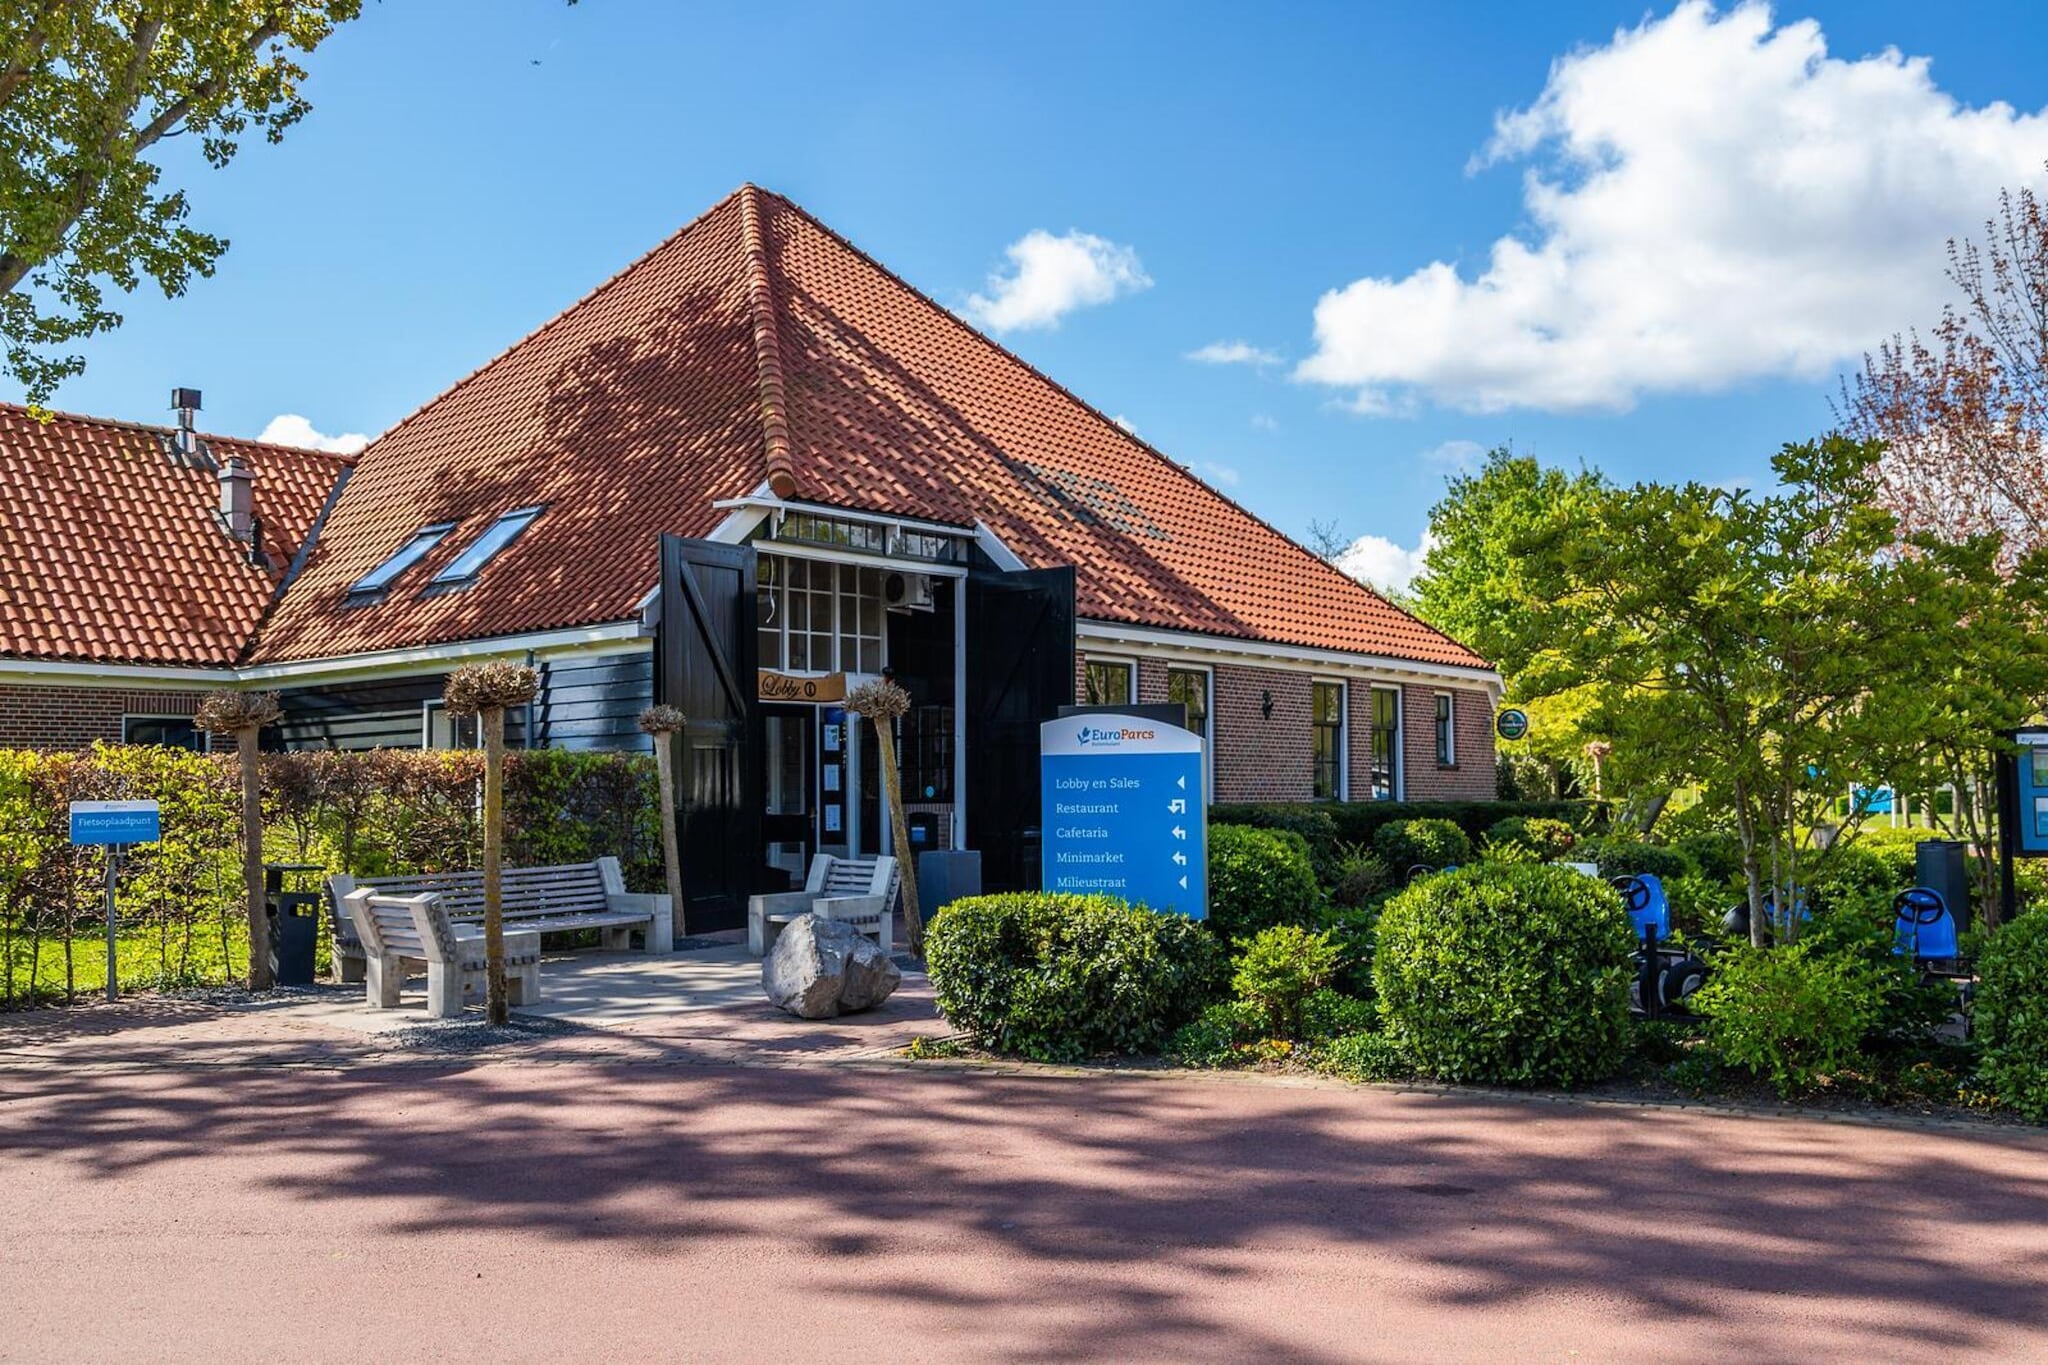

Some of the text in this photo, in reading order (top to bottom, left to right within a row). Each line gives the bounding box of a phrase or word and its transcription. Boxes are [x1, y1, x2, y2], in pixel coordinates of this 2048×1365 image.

[761, 675, 801, 699] Lobby
[1092, 728, 1154, 741] EuroParcs
[1056, 777, 1140, 791] Lobby en Sales
[1056, 803, 1119, 813] Restaurant
[78, 817, 151, 828] Fietsoplaadpunt
[1056, 827, 1108, 838] Cafetaria
[1056, 852, 1124, 863] Minimarket
[1057, 876, 1126, 888] Milieustraat
